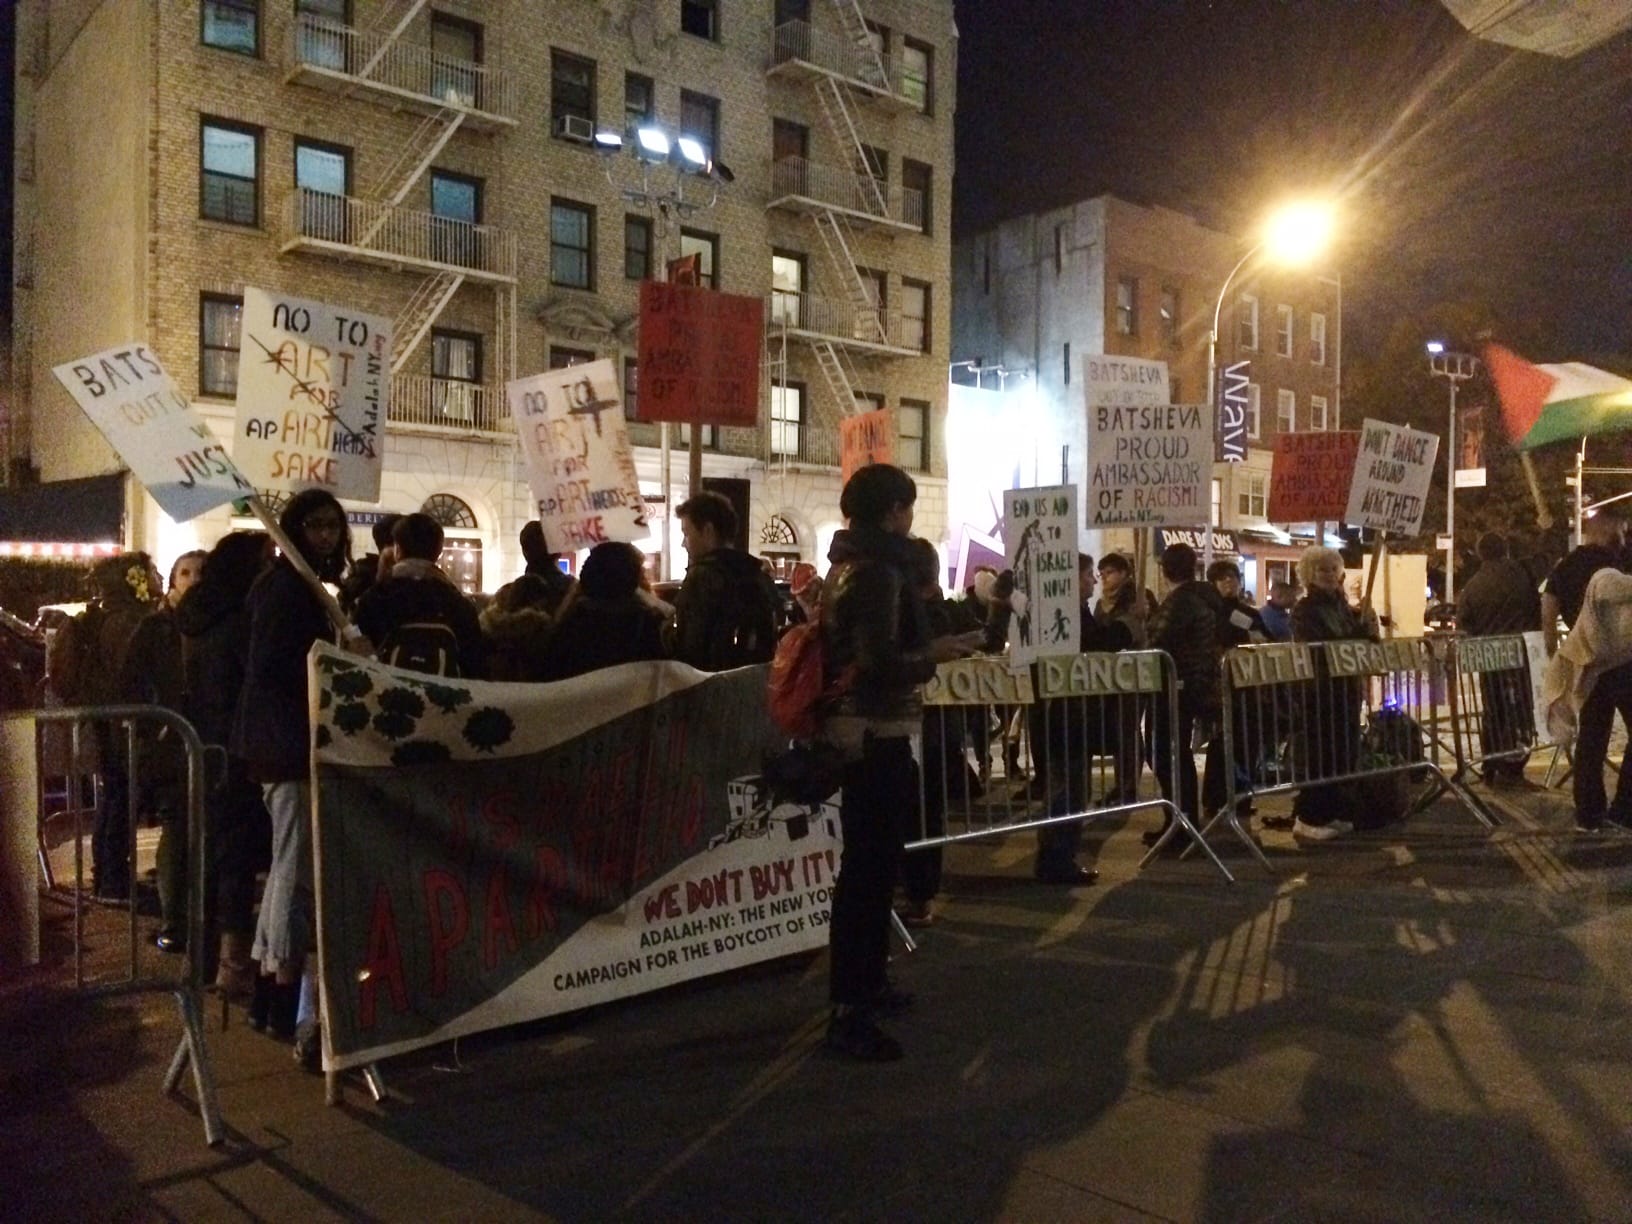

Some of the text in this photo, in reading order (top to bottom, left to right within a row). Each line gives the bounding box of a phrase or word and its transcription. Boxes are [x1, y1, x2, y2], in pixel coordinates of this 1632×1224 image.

[273, 303, 368, 347] NO TO
[72, 346, 162, 398] BATS
[275, 340, 354, 387] ART
[1089, 361, 1162, 385] BATSHEVA
[1098, 405, 1201, 432] BATSHEVA
[1116, 436, 1189, 461] PROUD
[1282, 433, 1359, 454] BATSHEV
[1393, 432, 1429, 466] DANCE
[271, 451, 338, 486] SAKE
[1093, 462, 1200, 487] AMBASSADOR
[1034, 497, 1048, 517] US
[1099, 489, 1123, 510] OF
[1047, 526, 1061, 540] TO
[1037, 550, 1073, 573] ISRAEL
[1043, 578, 1071, 599] NOW!
[1045, 655, 1154, 692] DANCE
[643, 883, 681, 923] WE
[749, 858, 795, 900] BUY
[802, 850, 836, 887] IT!
[640, 886, 835, 949] ADALAH-NY: THE NEW YOR
[554, 910, 831, 991] CAMPAIGN FOR THE BOYCOTT OF ISR
